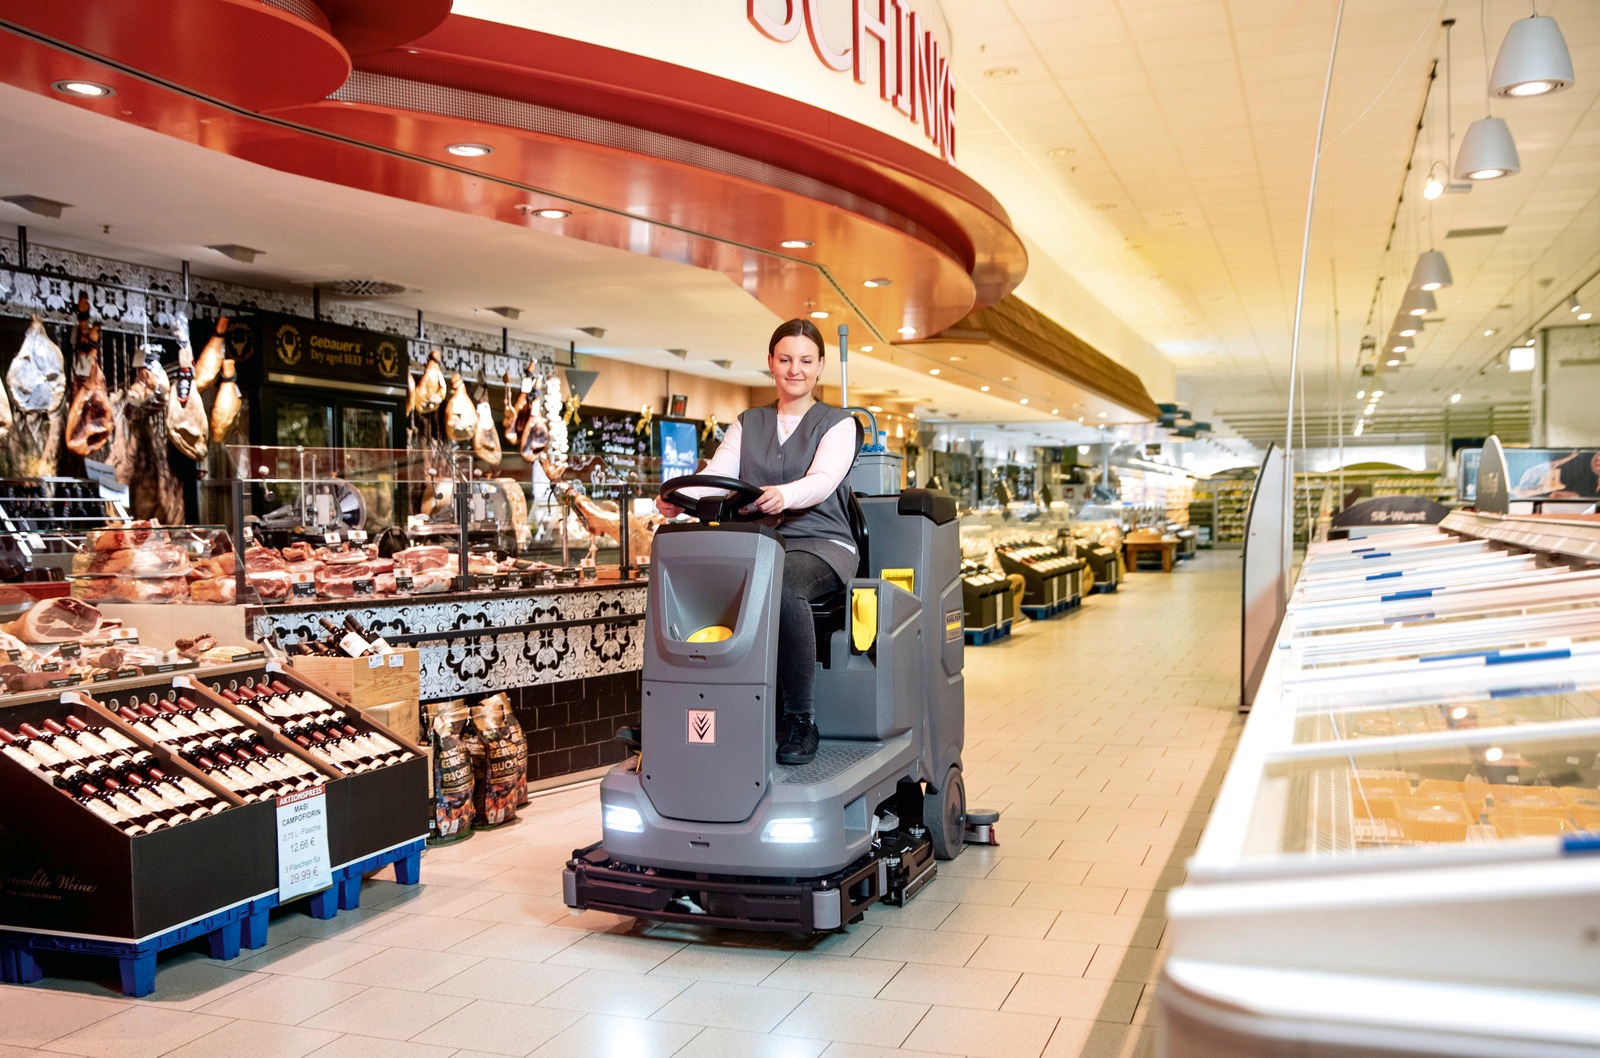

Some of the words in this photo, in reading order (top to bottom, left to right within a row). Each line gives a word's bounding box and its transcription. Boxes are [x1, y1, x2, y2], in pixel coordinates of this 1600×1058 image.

[311, 349, 324, 364] Dry
[326, 354, 343, 366] aged
[1371, 510, 1427, 522] SB-Wurst
[279, 787, 322, 805] AKTIONSPREIS
[294, 803, 308, 813] MASI
[281, 809, 321, 826] CAMPOFIORIN
[301, 824, 321, 835] Flasche
[310, 837, 316, 847] €
[289, 858, 313, 871] Flaschen
[290, 869, 311, 885] 29,99
[313, 866, 319, 877] €
[56, 874, 97, 893] Weine
